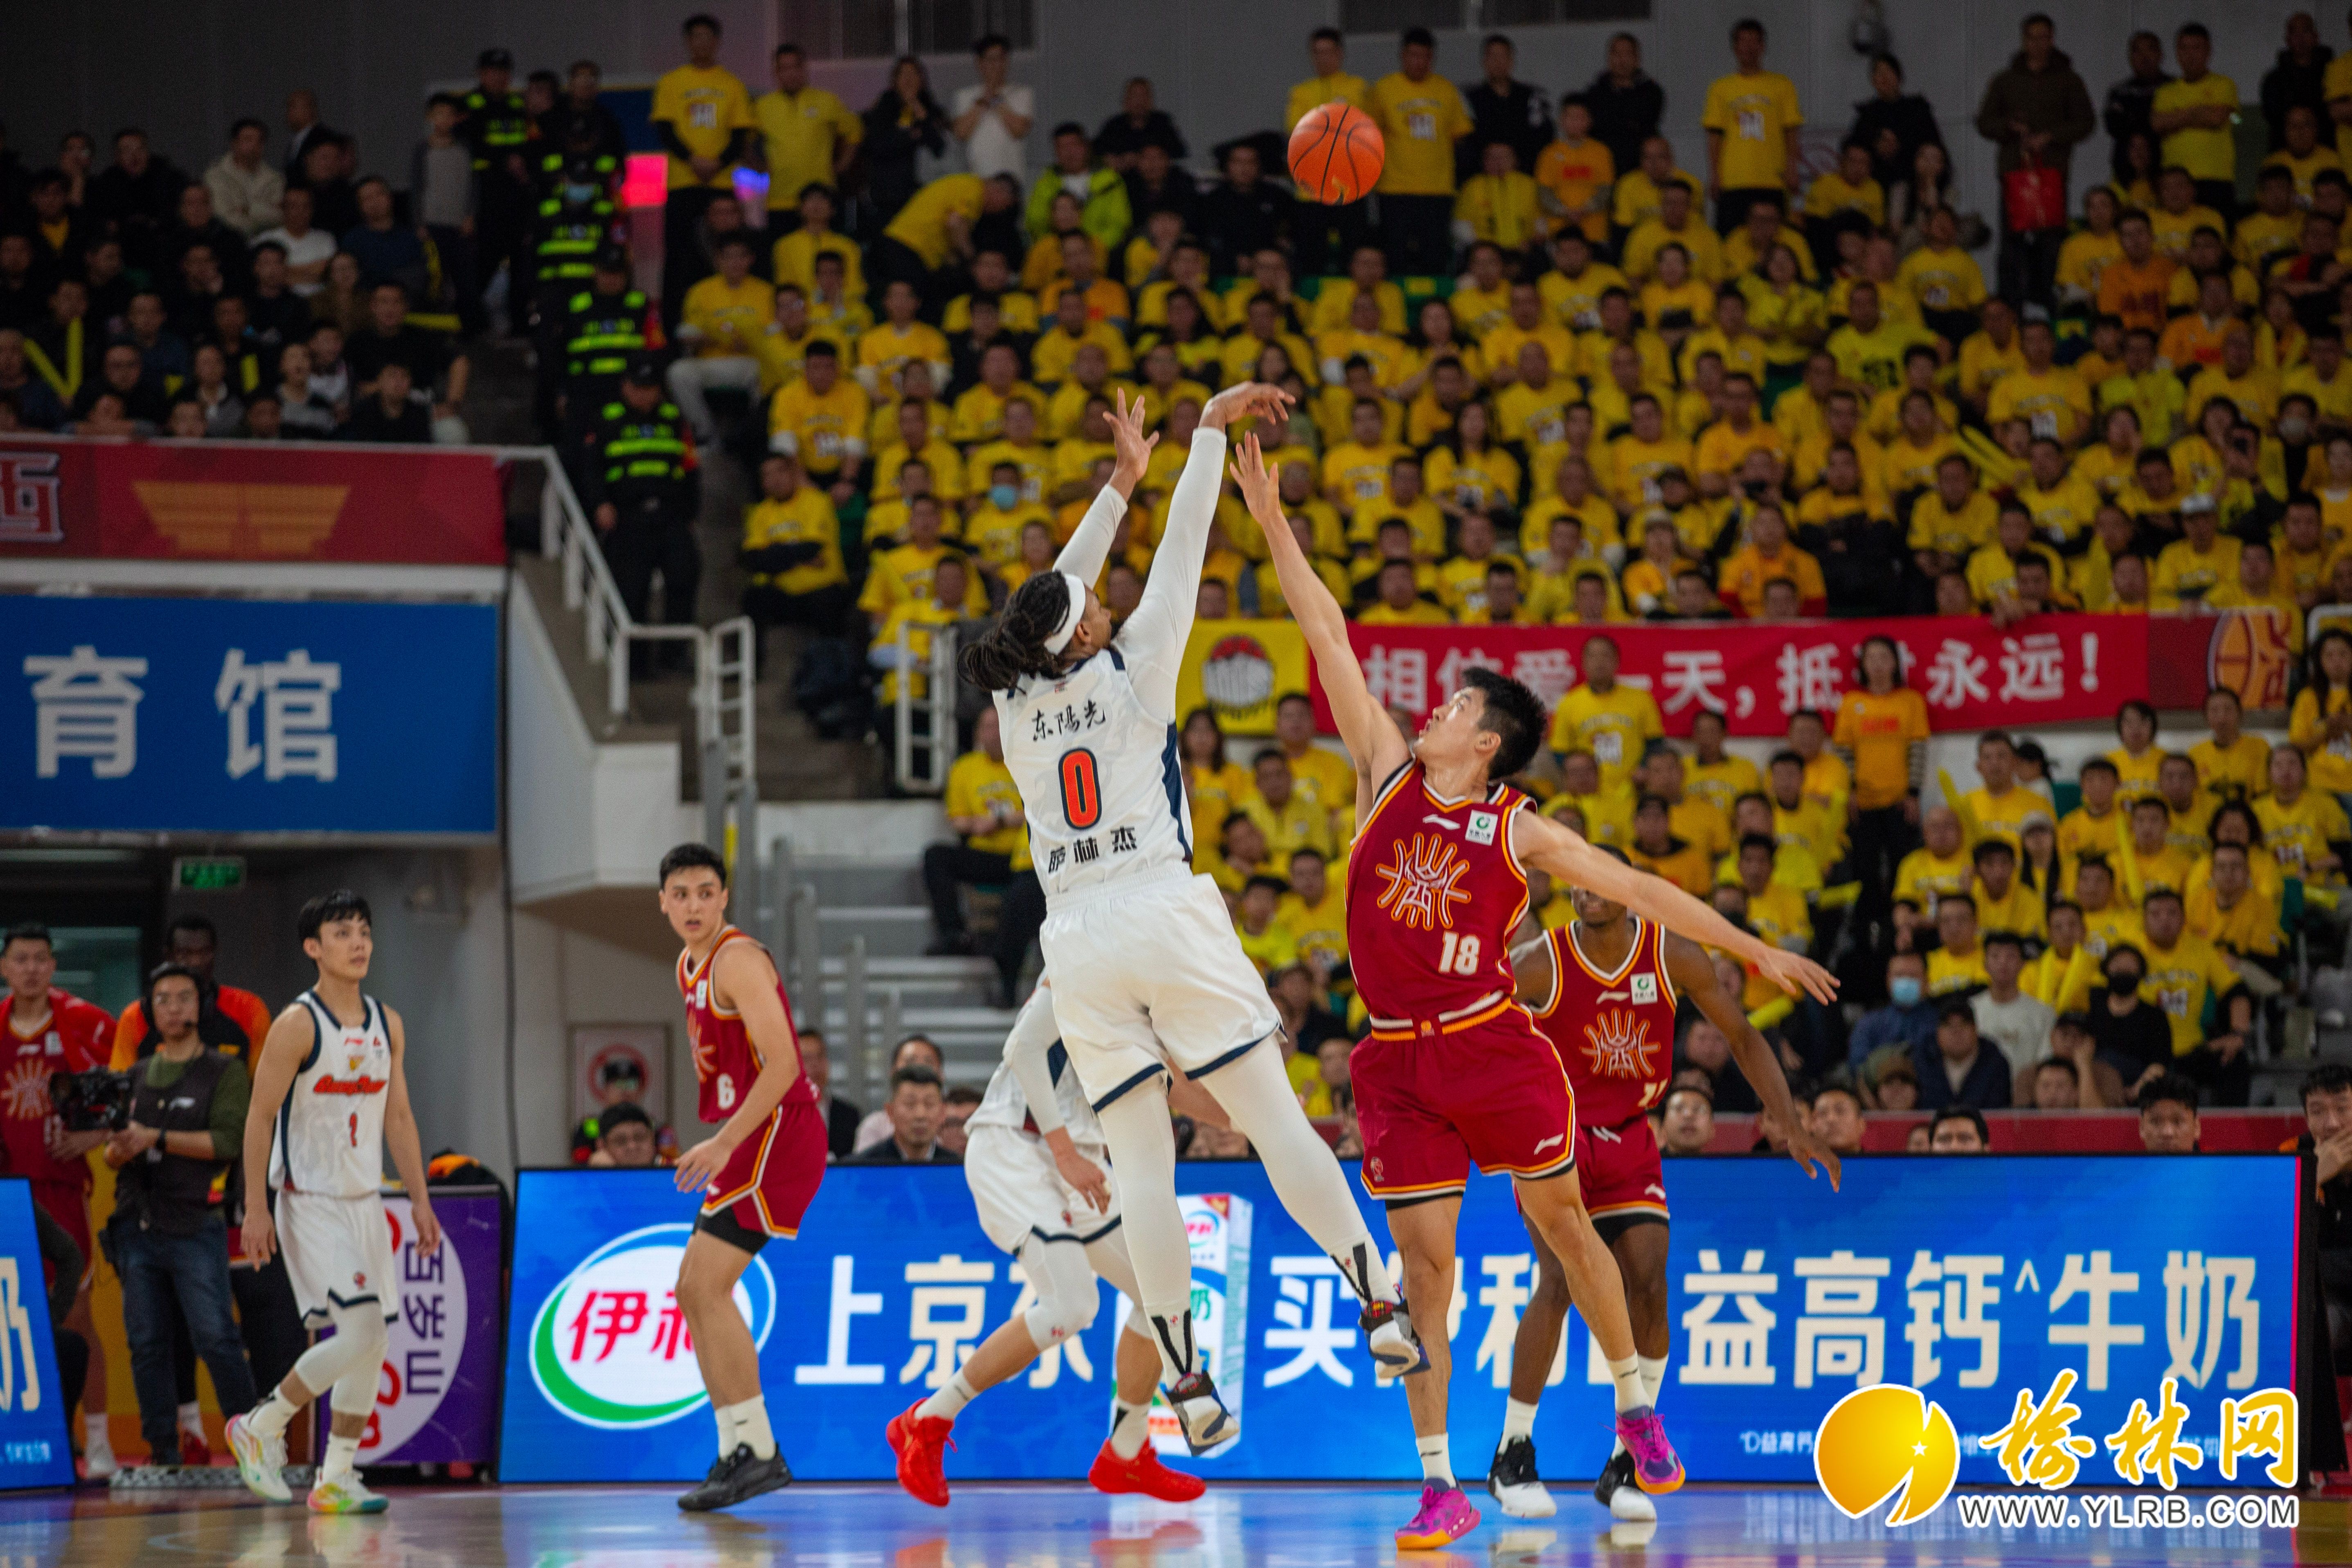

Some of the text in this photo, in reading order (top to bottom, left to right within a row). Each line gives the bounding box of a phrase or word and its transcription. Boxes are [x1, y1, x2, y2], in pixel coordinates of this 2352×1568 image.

[23, 645, 342, 783] 育馆
[1058, 747, 1102, 830] 0
[1438, 930, 1481, 976] 18
[716, 1073, 736, 1110] 6
